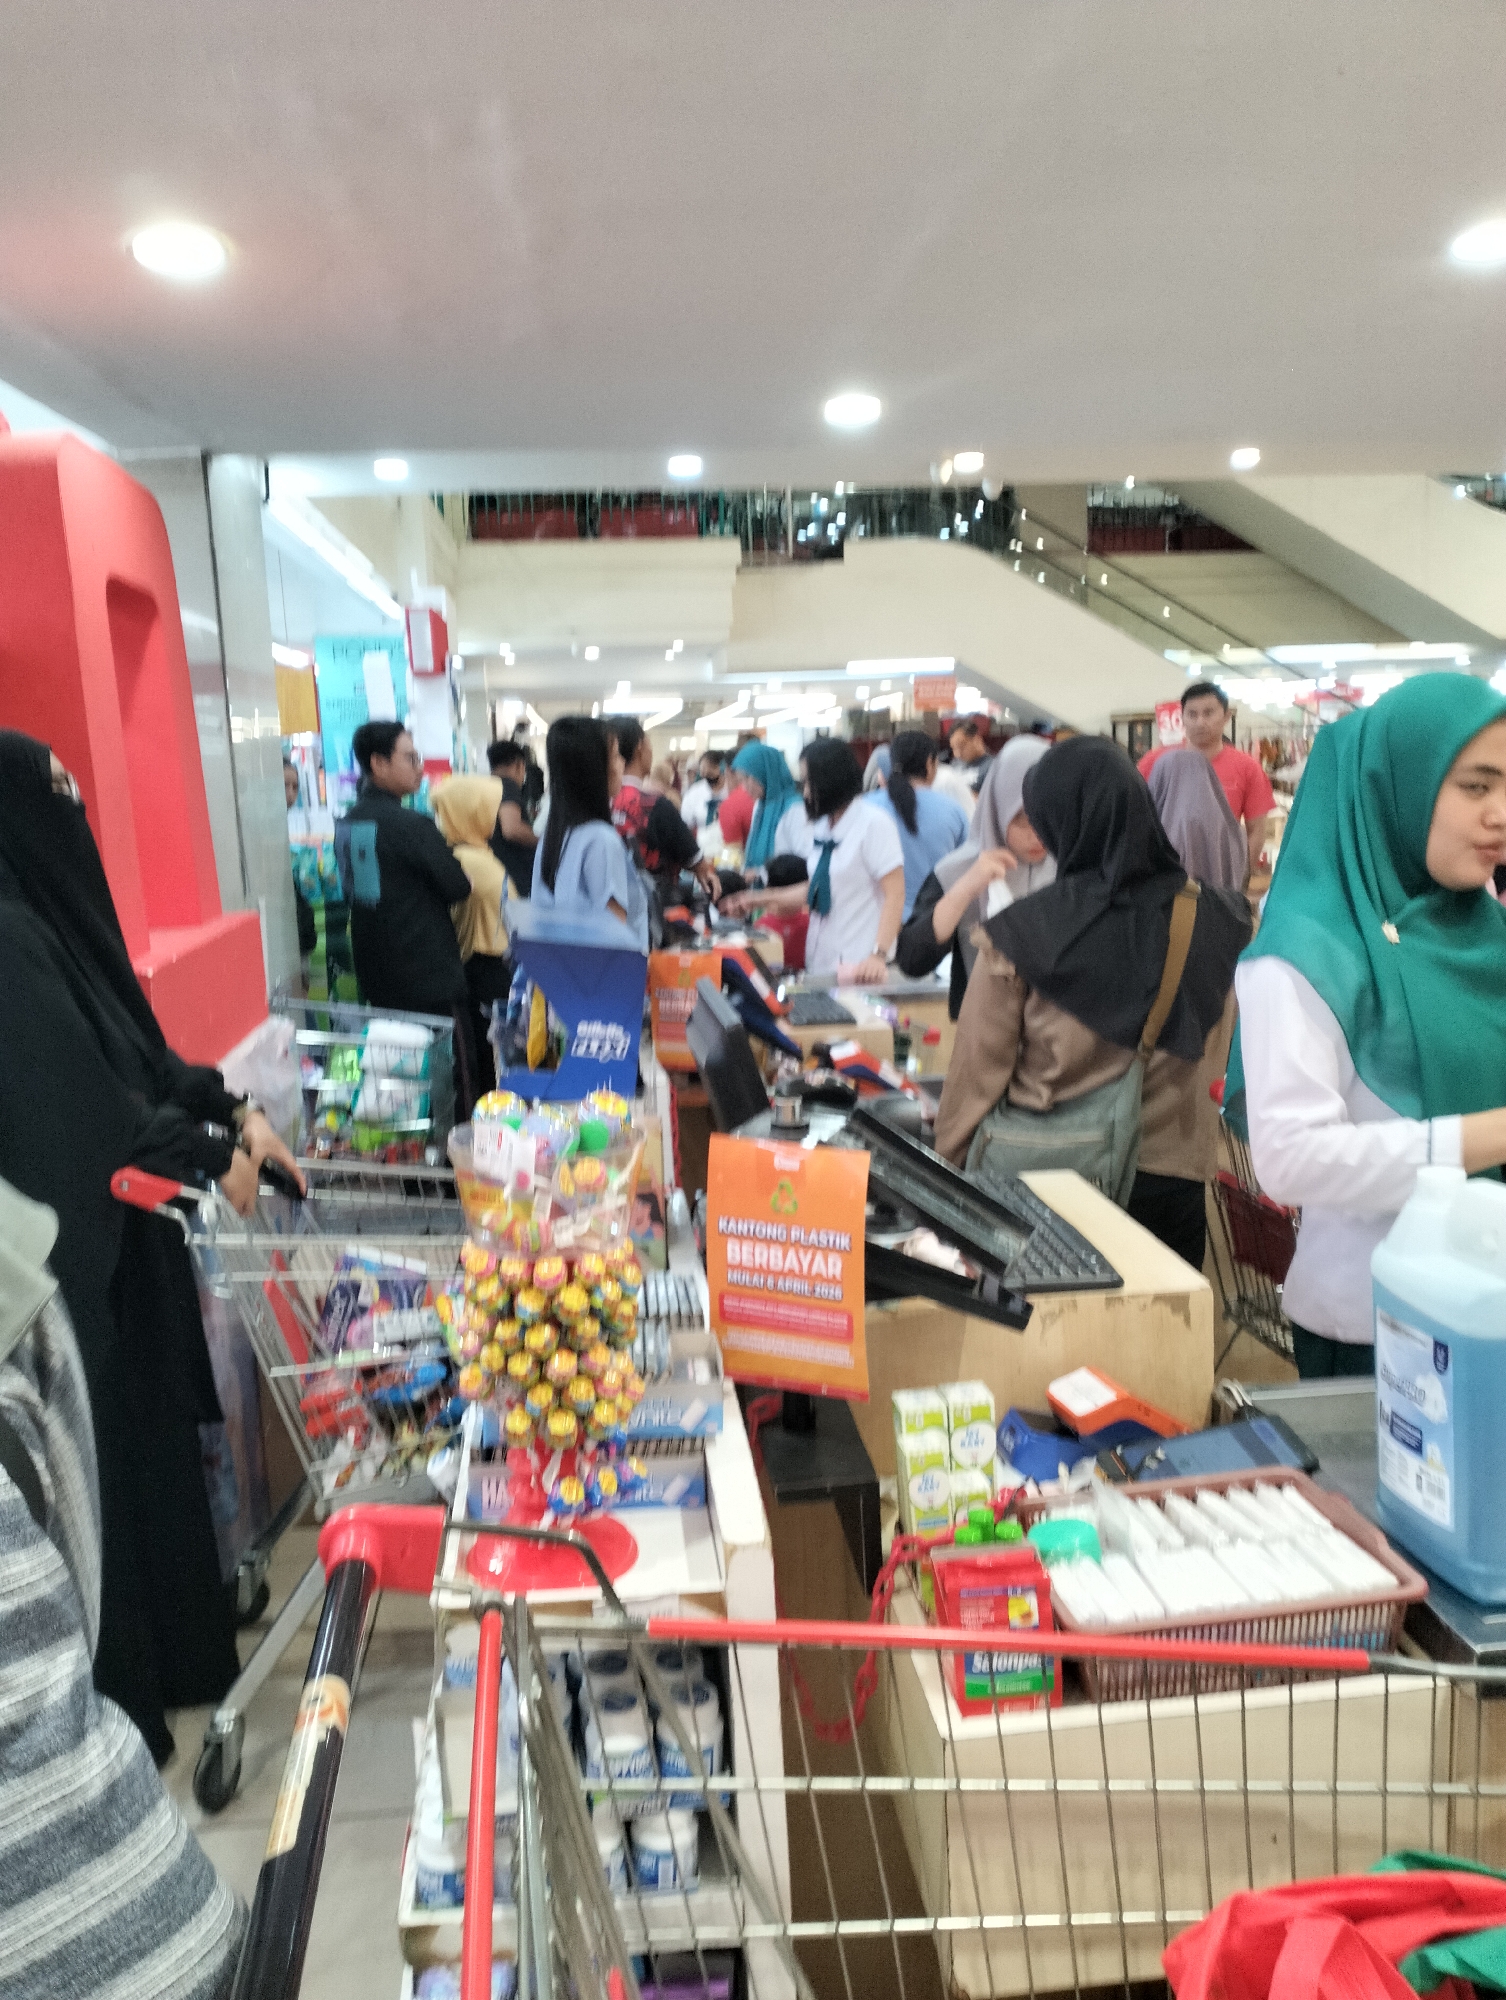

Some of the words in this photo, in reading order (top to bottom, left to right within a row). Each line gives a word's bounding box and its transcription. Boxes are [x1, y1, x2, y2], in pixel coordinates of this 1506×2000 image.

[718, 1215, 788, 1243] KANTONG
[790, 1224, 852, 1251] PLASTIK
[727, 1236, 843, 1281] BERBAYAR
[727, 1268, 765, 1290] MULAI
[777, 1275, 812, 1298] APRIL
[813, 1282, 844, 1301] 2026
